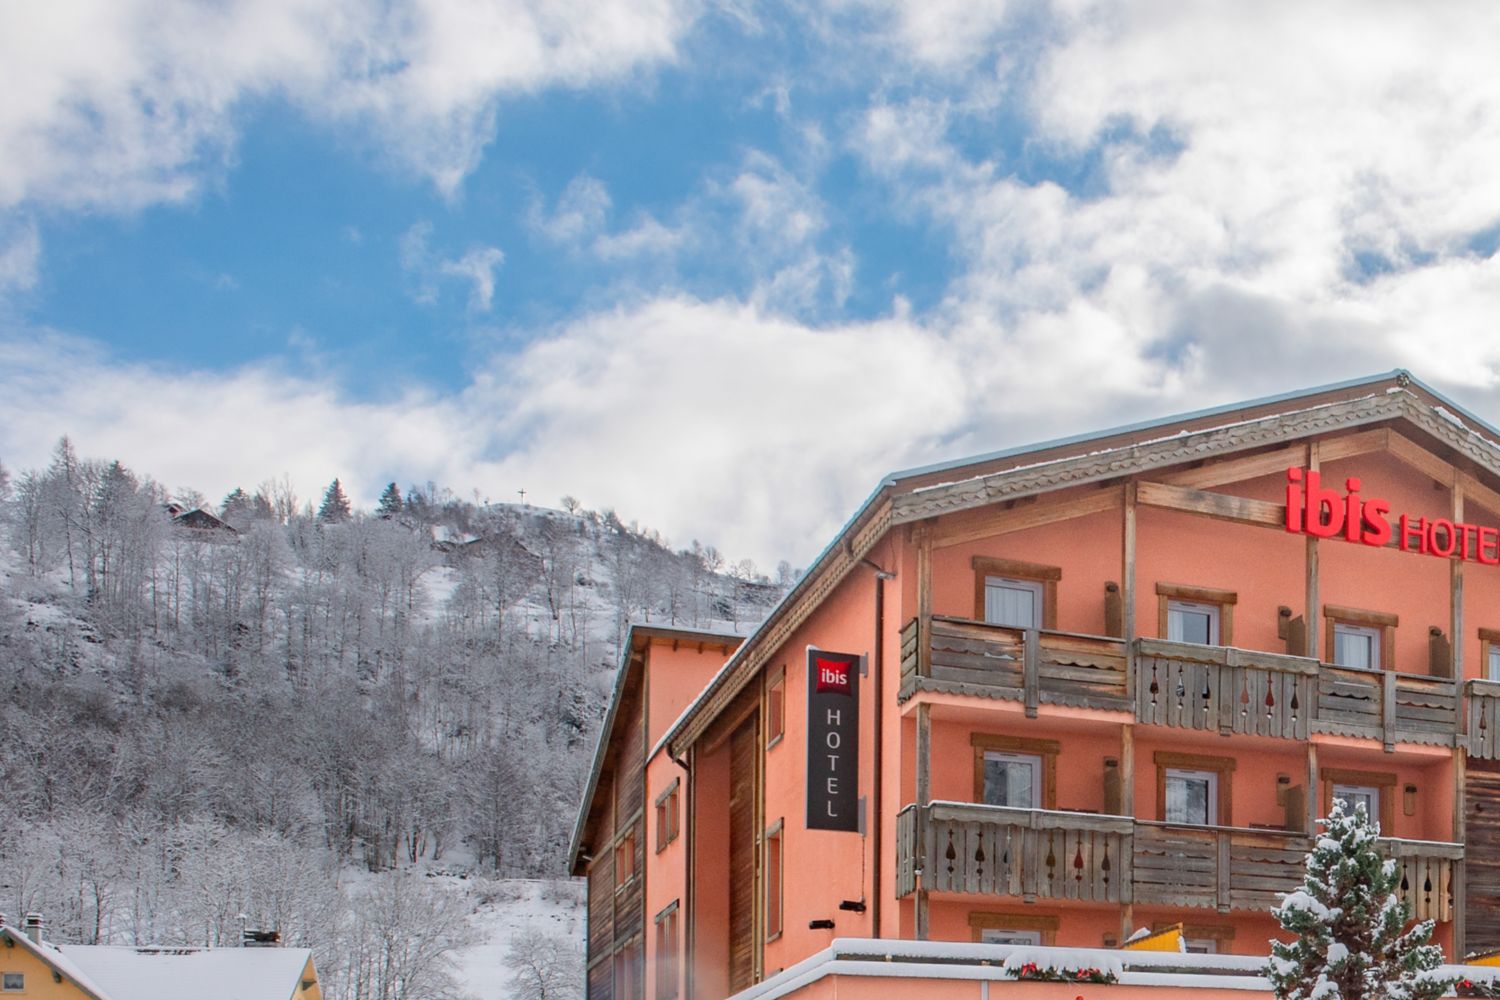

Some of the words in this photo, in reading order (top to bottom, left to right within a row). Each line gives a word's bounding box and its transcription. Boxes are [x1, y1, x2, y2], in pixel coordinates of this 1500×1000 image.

[1285, 466, 1392, 547] ibis
[821, 668, 848, 685] ibis
[826, 708, 841, 818] HOTEL
